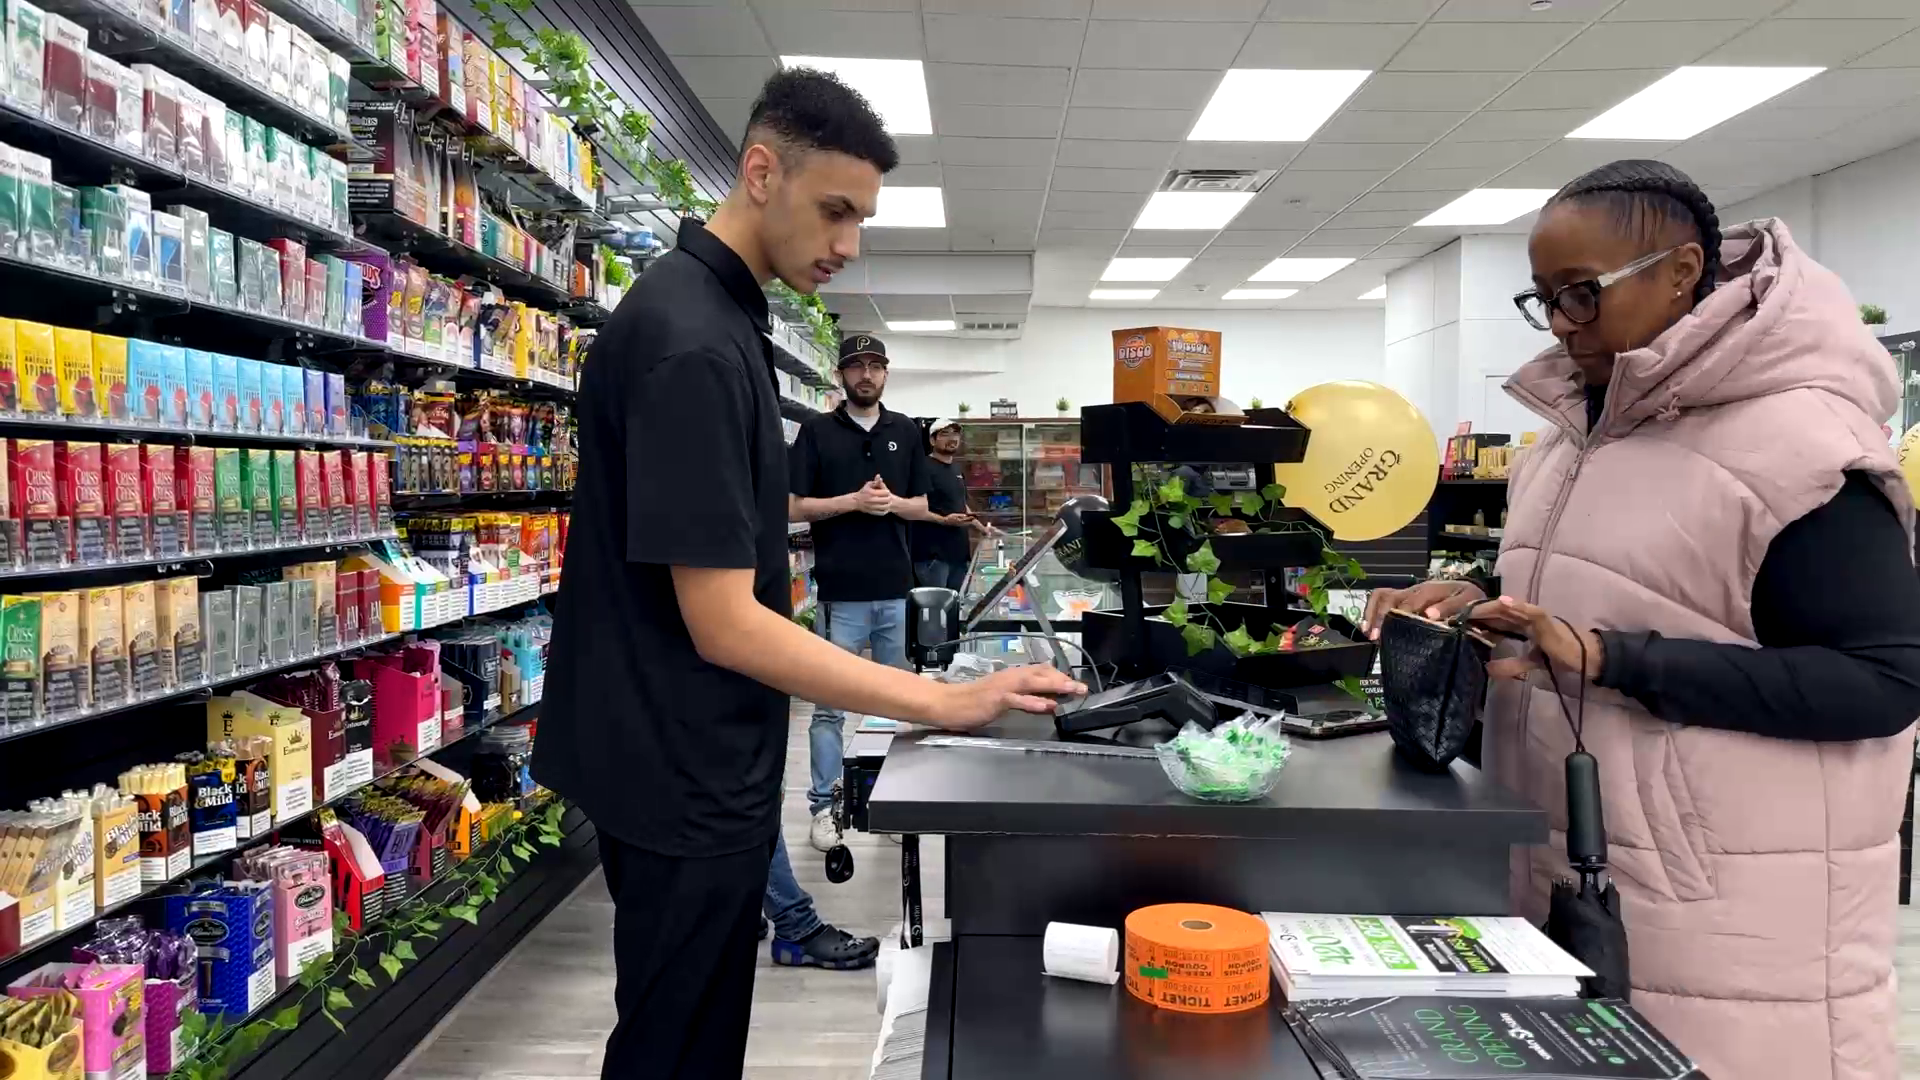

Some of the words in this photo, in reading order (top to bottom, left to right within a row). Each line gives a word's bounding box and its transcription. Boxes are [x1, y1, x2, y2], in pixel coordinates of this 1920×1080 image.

[1118, 343, 1152, 360] DISCO
[1323, 447, 1374, 494] OPENING
[1329, 449, 1400, 514] GRAND
[6, 624, 34, 643] CRISS
[5, 643, 34, 661] CROSS
[223, 719, 233, 732] E
[199, 783, 233, 798] Black
[204, 793, 233, 809] Mild
[169, 803, 188, 818] Black
[138, 820, 162, 833] ild
[1353, 917, 1388, 938] OFF
[1306, 935, 1355, 965] 420
[1373, 940, 1412, 965] 50%
[1164, 959, 1208, 969] COUPON
[1159, 992, 1212, 1008] TICKET
[1224, 989, 1262, 1007] TICKET
[1414, 1008, 1479, 1064] GRAND
[1447, 1004, 1527, 1068] OPENING
